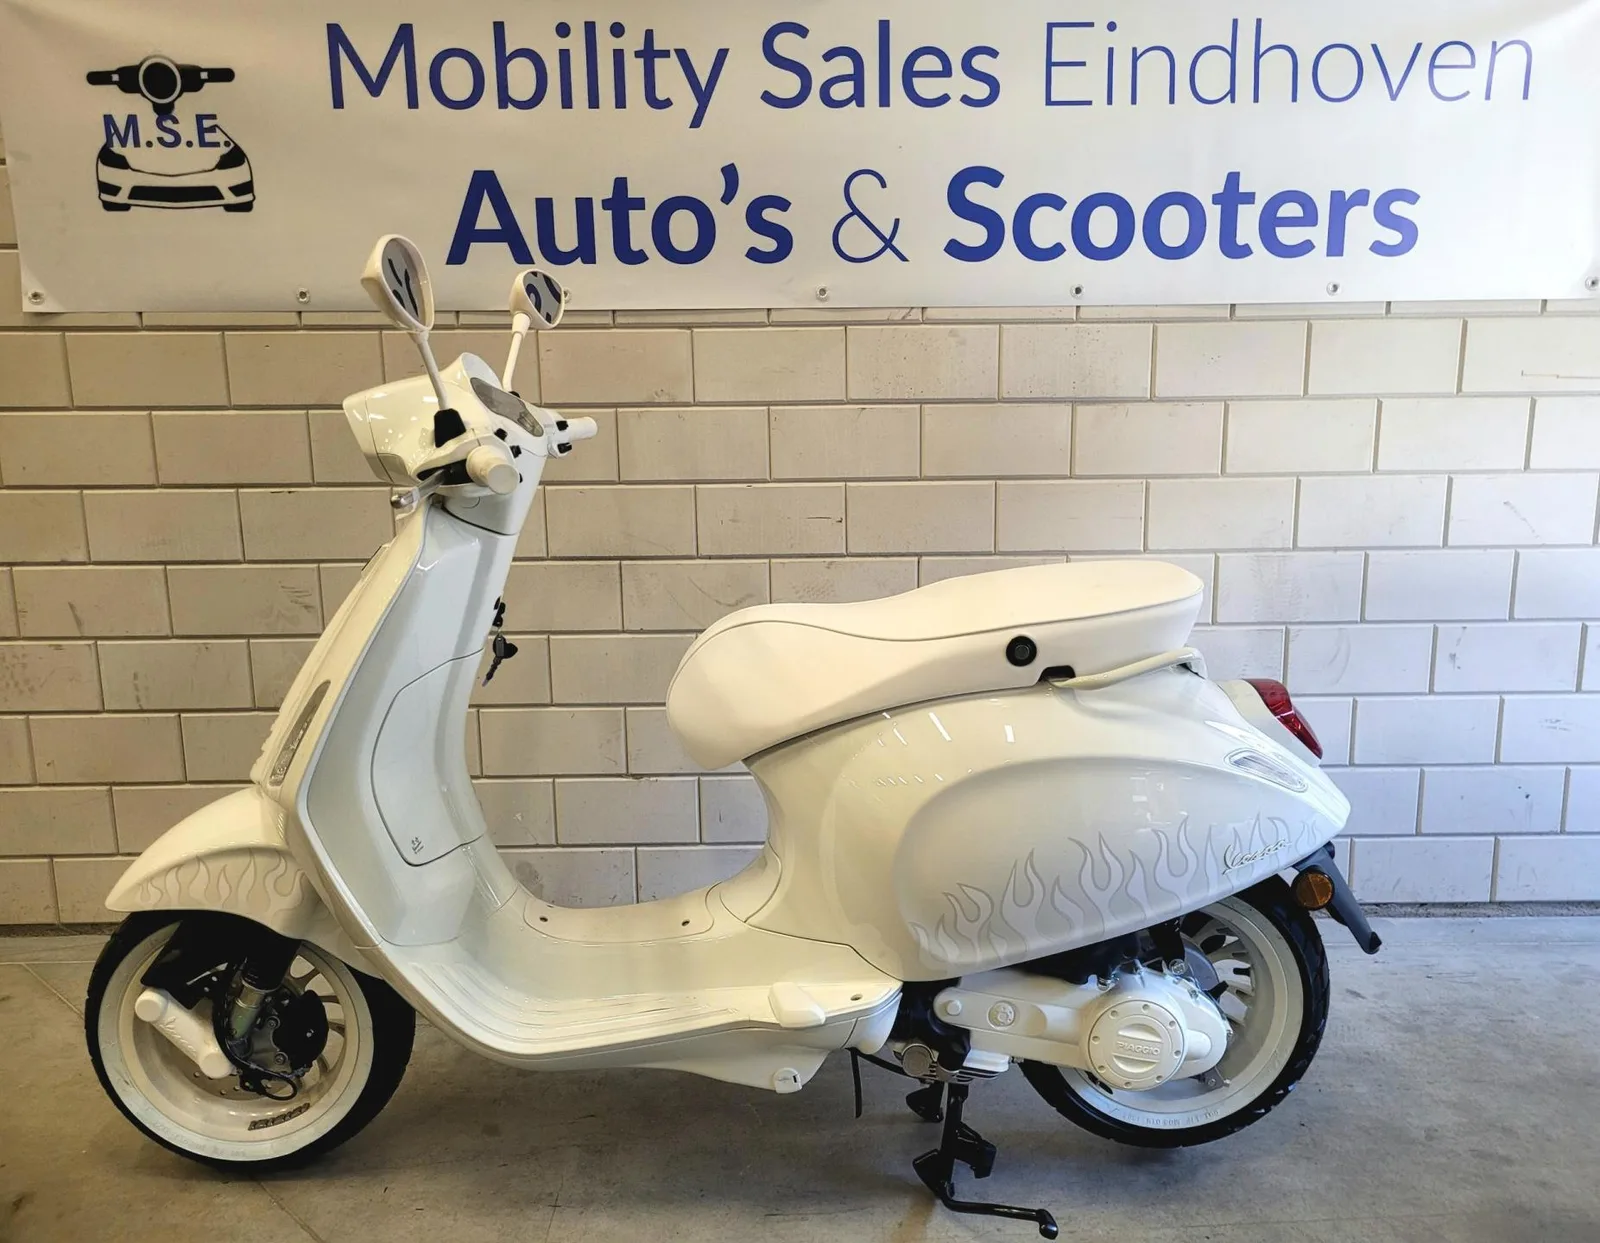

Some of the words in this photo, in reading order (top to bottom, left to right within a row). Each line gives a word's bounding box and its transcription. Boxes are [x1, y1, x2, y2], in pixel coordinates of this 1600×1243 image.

[326, 21, 729, 129] Mobility
[760, 19, 1001, 109] Sales
[1044, 17, 1534, 107] Eindhoven
[103, 114, 231, 148] M.S.E.
[446, 163, 794, 266] Auto's
[831, 168, 910, 263] &
[943, 165, 1421, 263] Scooters
[1222, 838, 1292, 876] Vespa
[1116, 1040, 1161, 1056] PIAGGIO
